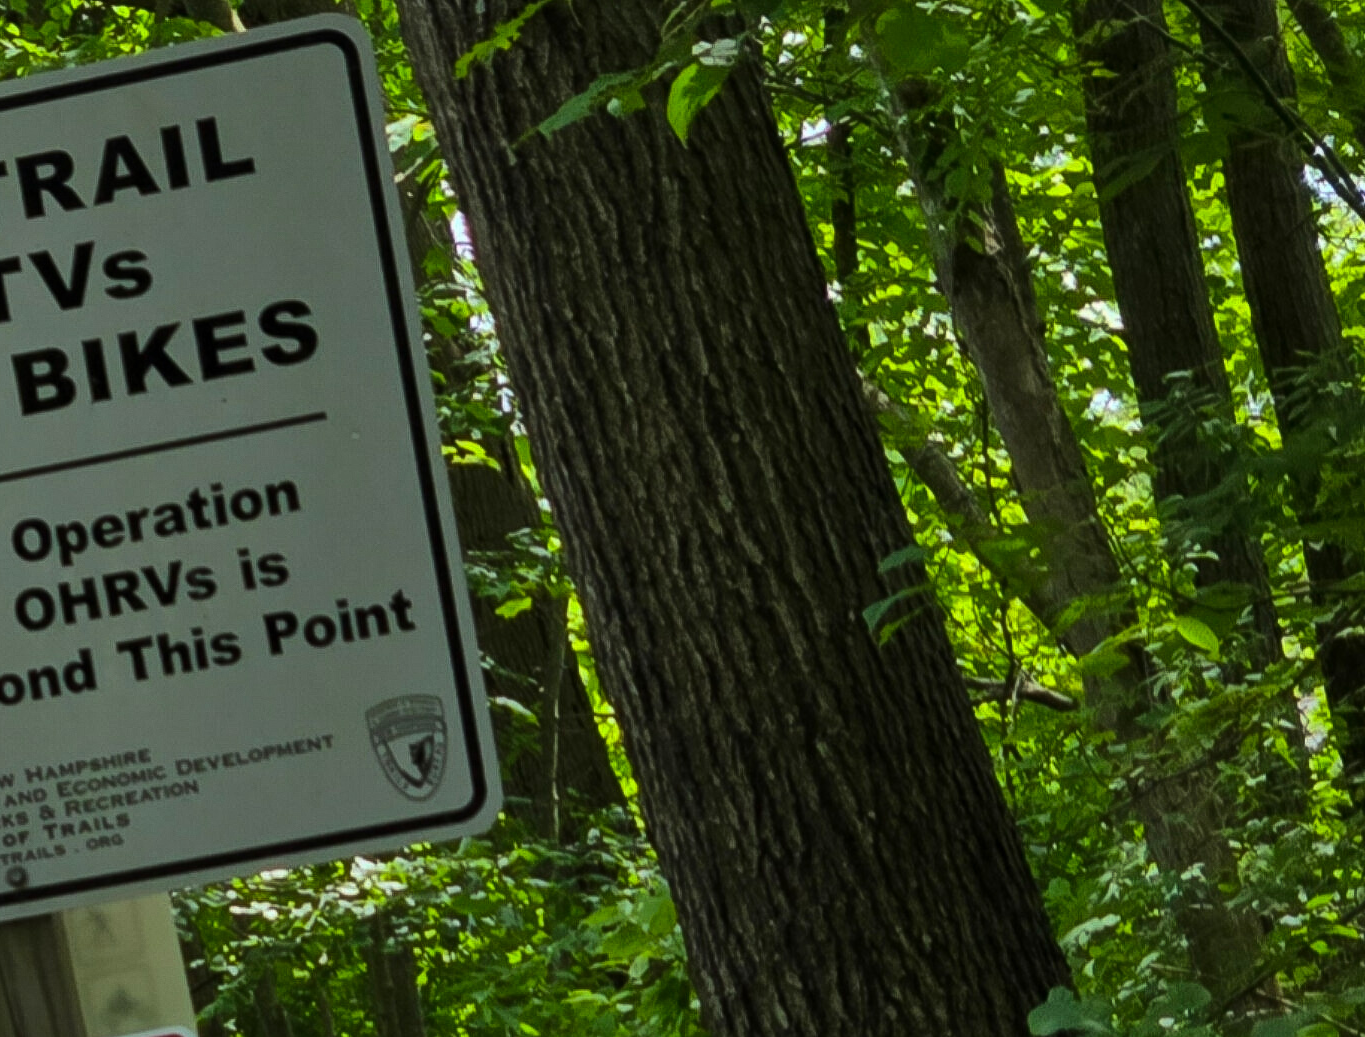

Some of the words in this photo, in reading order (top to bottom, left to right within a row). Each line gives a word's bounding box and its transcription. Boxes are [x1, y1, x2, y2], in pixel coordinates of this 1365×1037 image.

[11, 299, 319, 417] BIKES
[12, 478, 301, 567] Operation
[15, 560, 217, 634] OHRVs
[239, 547, 290, 592] is
[117, 623, 243, 683] This
[264, 589, 416, 656] Point
[39, 804, 56, 821] &
